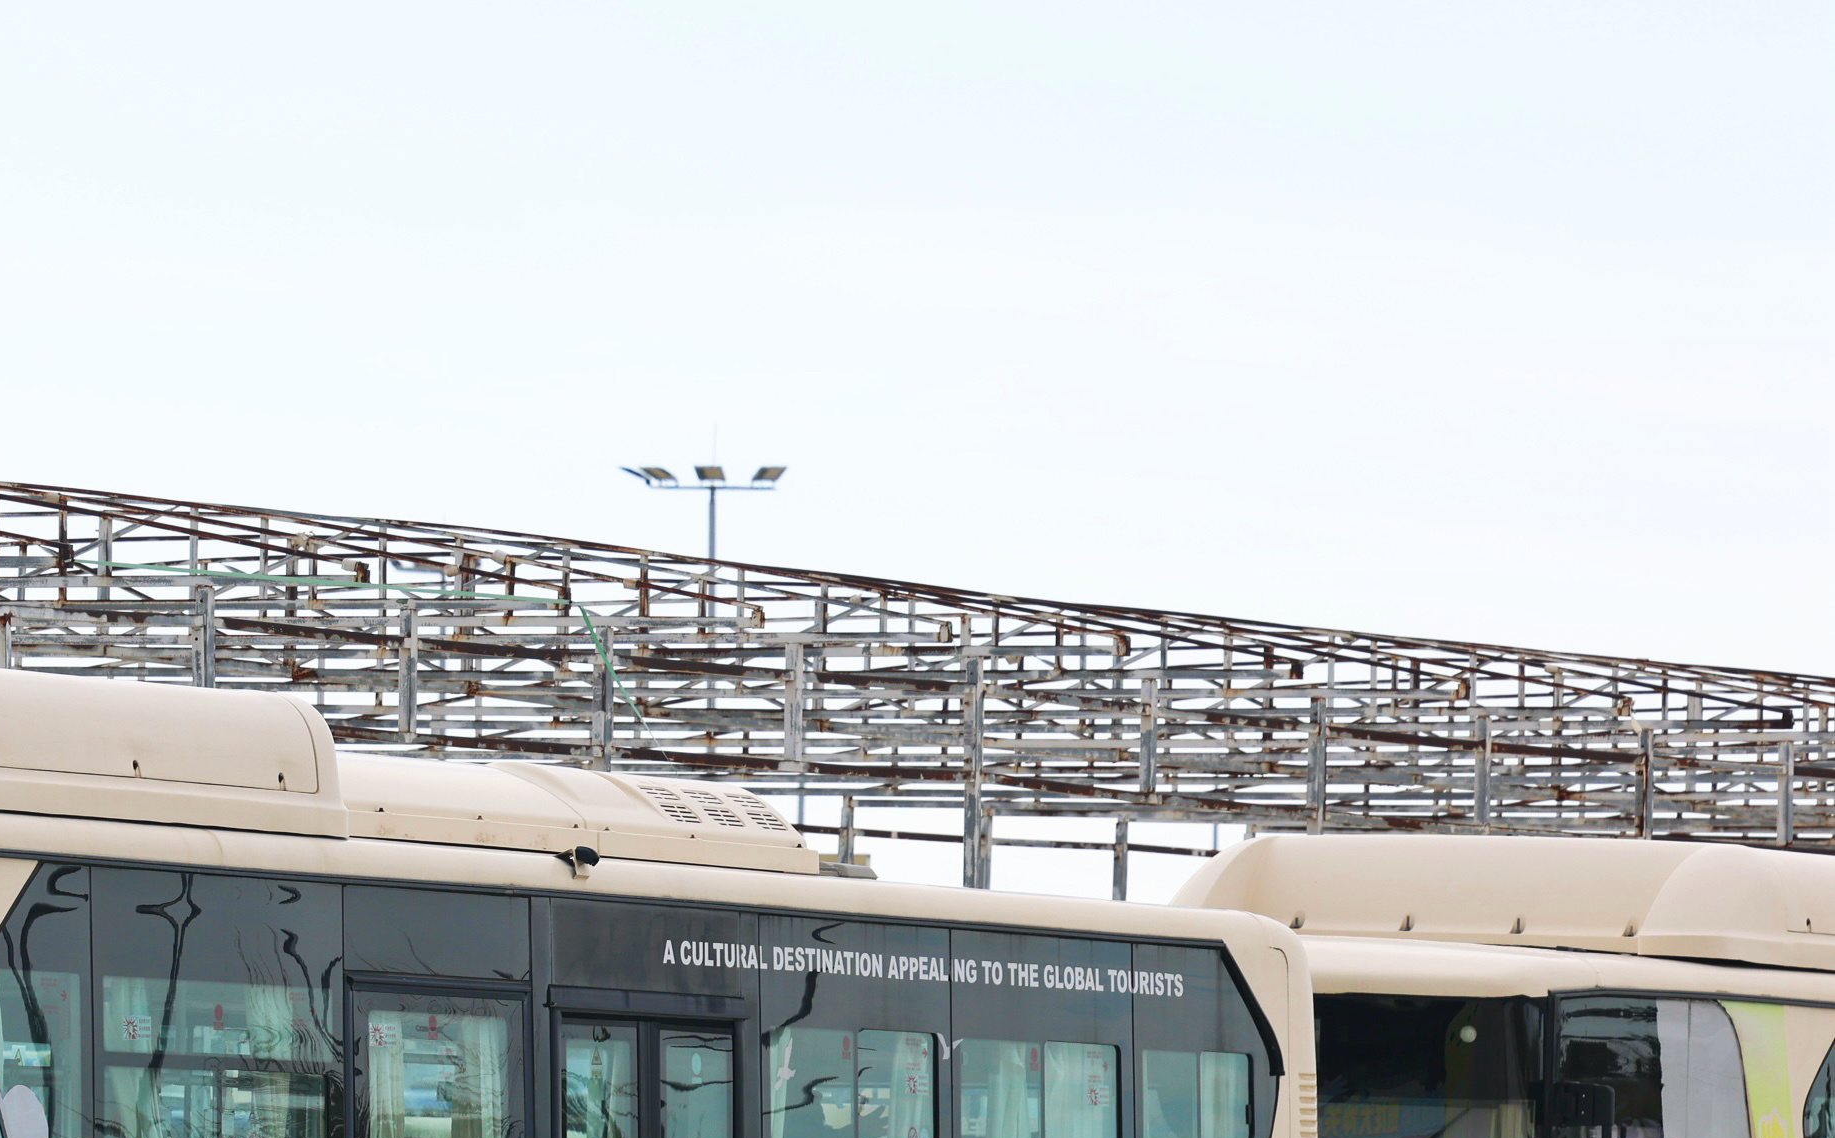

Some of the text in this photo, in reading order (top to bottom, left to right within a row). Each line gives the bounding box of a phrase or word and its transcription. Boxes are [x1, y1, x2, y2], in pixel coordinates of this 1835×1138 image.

[663, 939, 676, 965] A
[680, 941, 767, 970] CULTURAL
[772, 946, 884, 978] DESTINATION
[981, 961, 1003, 986] TO
[1007, 963, 1040, 989] THE
[1043, 965, 1104, 992] GLOBAL
[1108, 969, 1184, 997] TOURISTS
